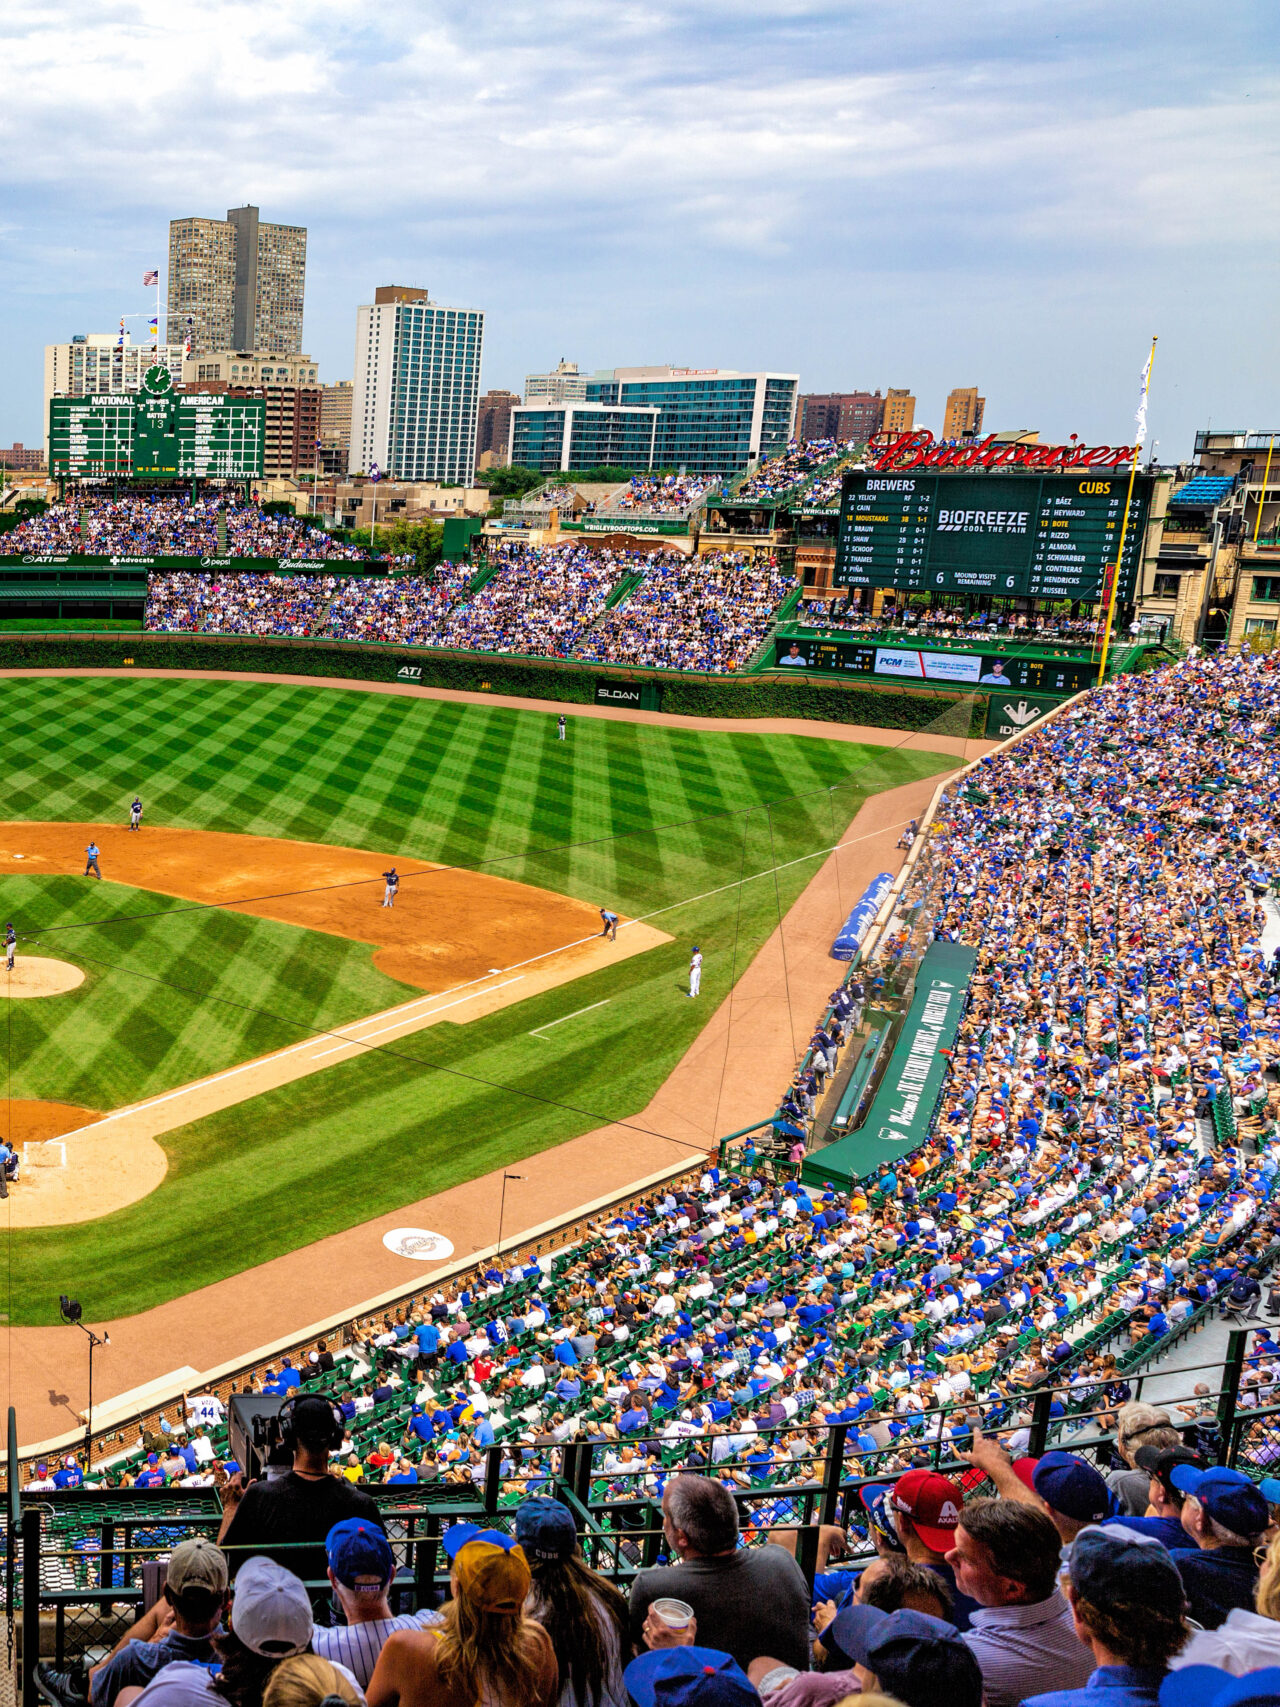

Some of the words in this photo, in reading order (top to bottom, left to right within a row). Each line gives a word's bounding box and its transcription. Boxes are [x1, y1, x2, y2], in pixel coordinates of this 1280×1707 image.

[91, 396, 135, 405] NATIONAL
[180, 396, 225, 406] AMERICAN
[870, 429, 1143, 471] Budweiser
[866, 479, 916, 491] BREWERS
[1078, 481, 1112, 494] CUBS
[803, 507, 840, 516] WRIGLEYR
[1053, 509, 1086, 517] HEYWARD
[584, 523, 659, 533] WRIGLEYROOFTOPS.COM
[1052, 520, 1069, 528] BOTE
[854, 525, 874, 533] BRAUN
[1006, 526, 1027, 534] PAIN
[851, 545, 874, 553] SCHOOP
[1048, 543, 1077, 551] ALMORA
[1035, 553, 1044, 561] 12
[1046, 553, 1086, 562] SCHWARBER
[210, 558, 231, 567] pepsi
[277, 558, 326, 570] Budweiser
[1045, 565, 1083, 573] CONTRERAS
[935, 571, 945, 584] 6
[1005, 575, 1015, 588] 6
[1043, 576, 1080, 584] HENDRICKS
[1042, 587, 1068, 595] RUSSELL
[879, 657, 902, 666] PCM
[397, 665, 422, 676] ATI
[597, 688, 640, 701] SLOAN
[200, 1407, 214, 1418] 44
